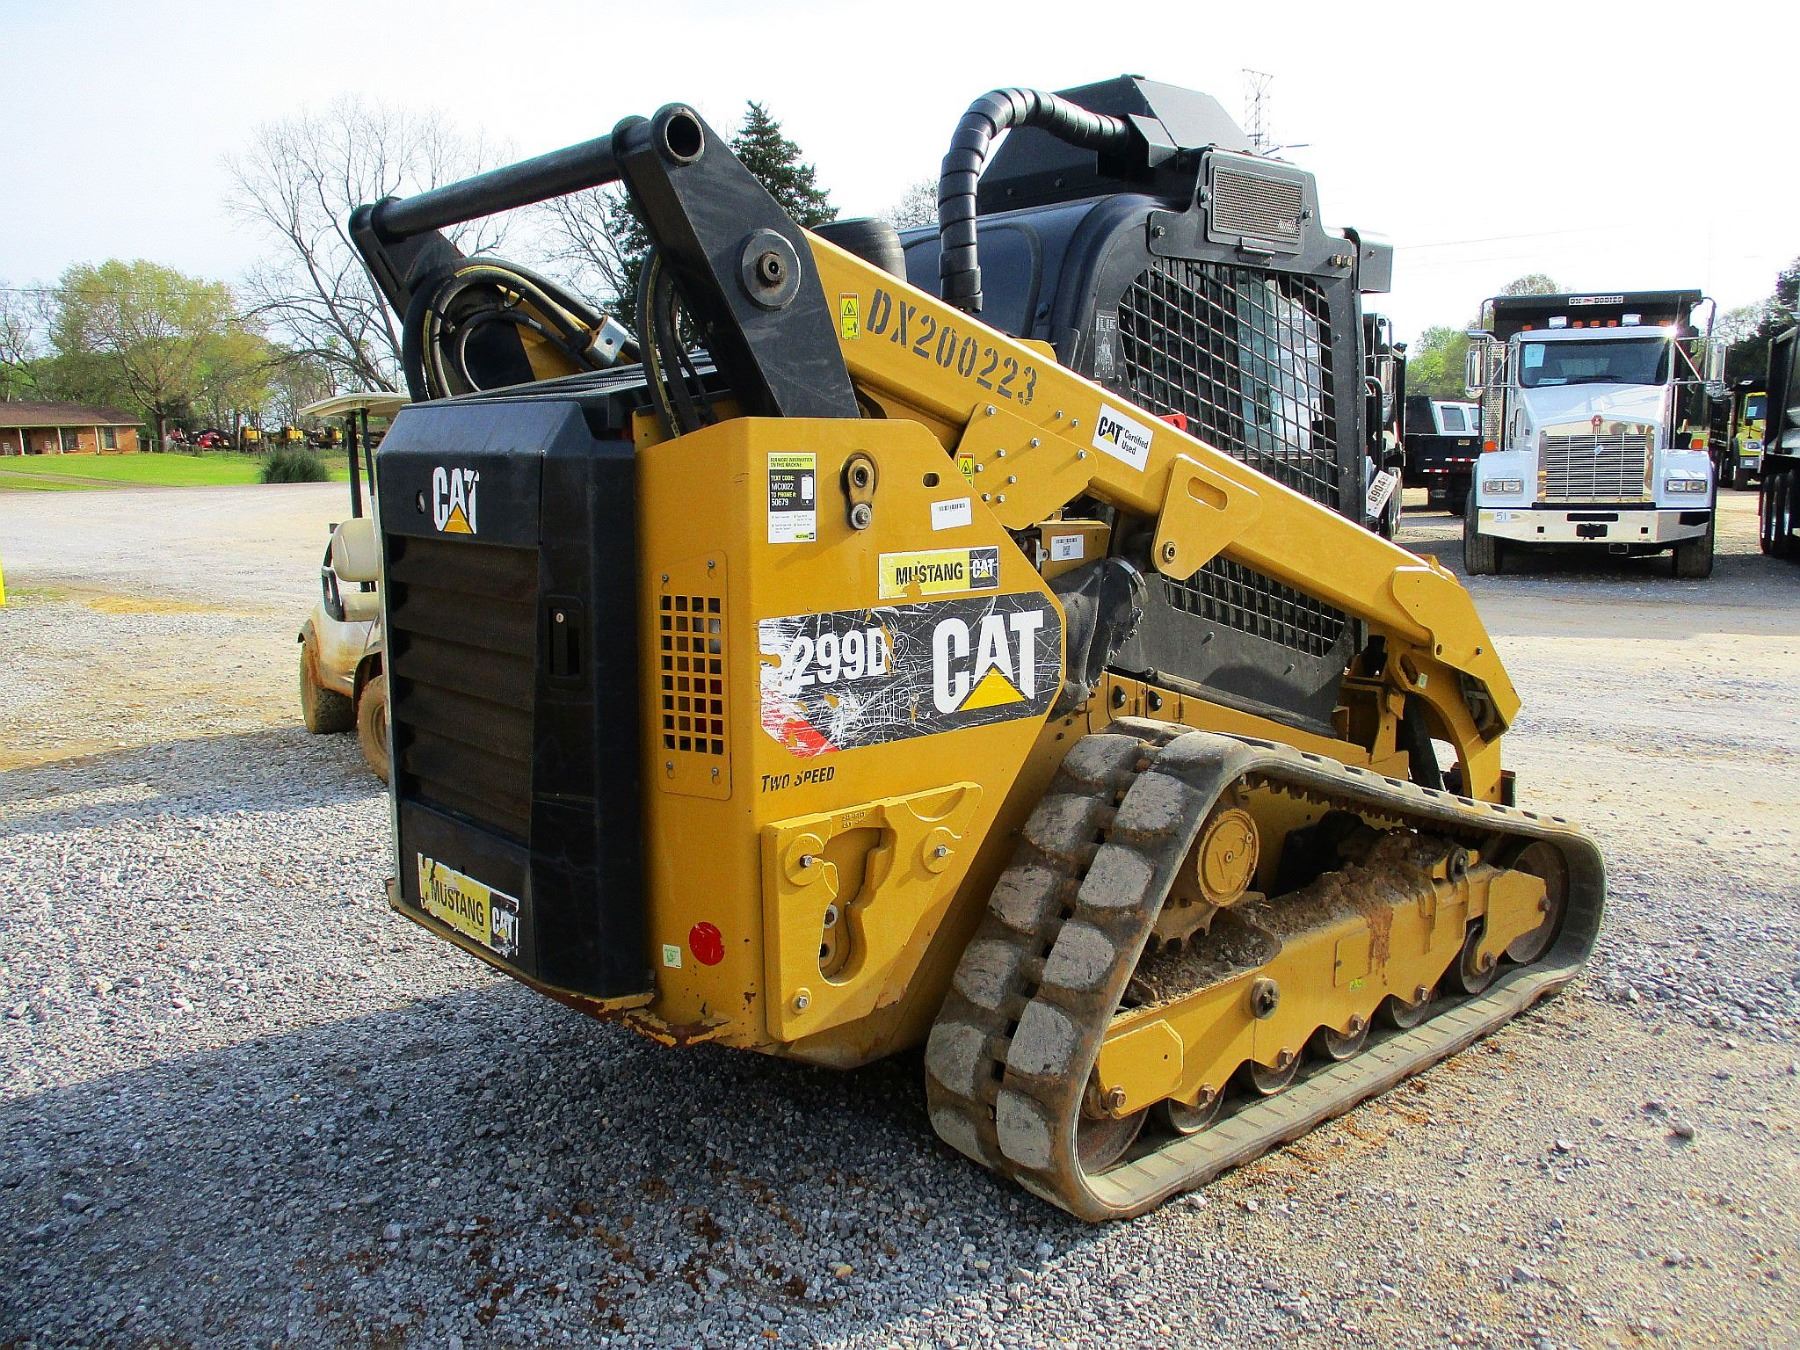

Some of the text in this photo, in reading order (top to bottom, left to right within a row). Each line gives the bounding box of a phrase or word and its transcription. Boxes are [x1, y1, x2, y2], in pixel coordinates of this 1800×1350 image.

[866, 288, 1037, 406] DX200223
[1098, 416, 1149, 449] CAT Certified
[1121, 440, 1136, 455] Used
[433, 466, 480, 535] CAT
[895, 558, 997, 585] MUSTANG CAT
[932, 610, 1044, 714] CAT
[762, 766, 835, 792] TWO SPEED
[430, 879, 485, 927] MUSTANG
